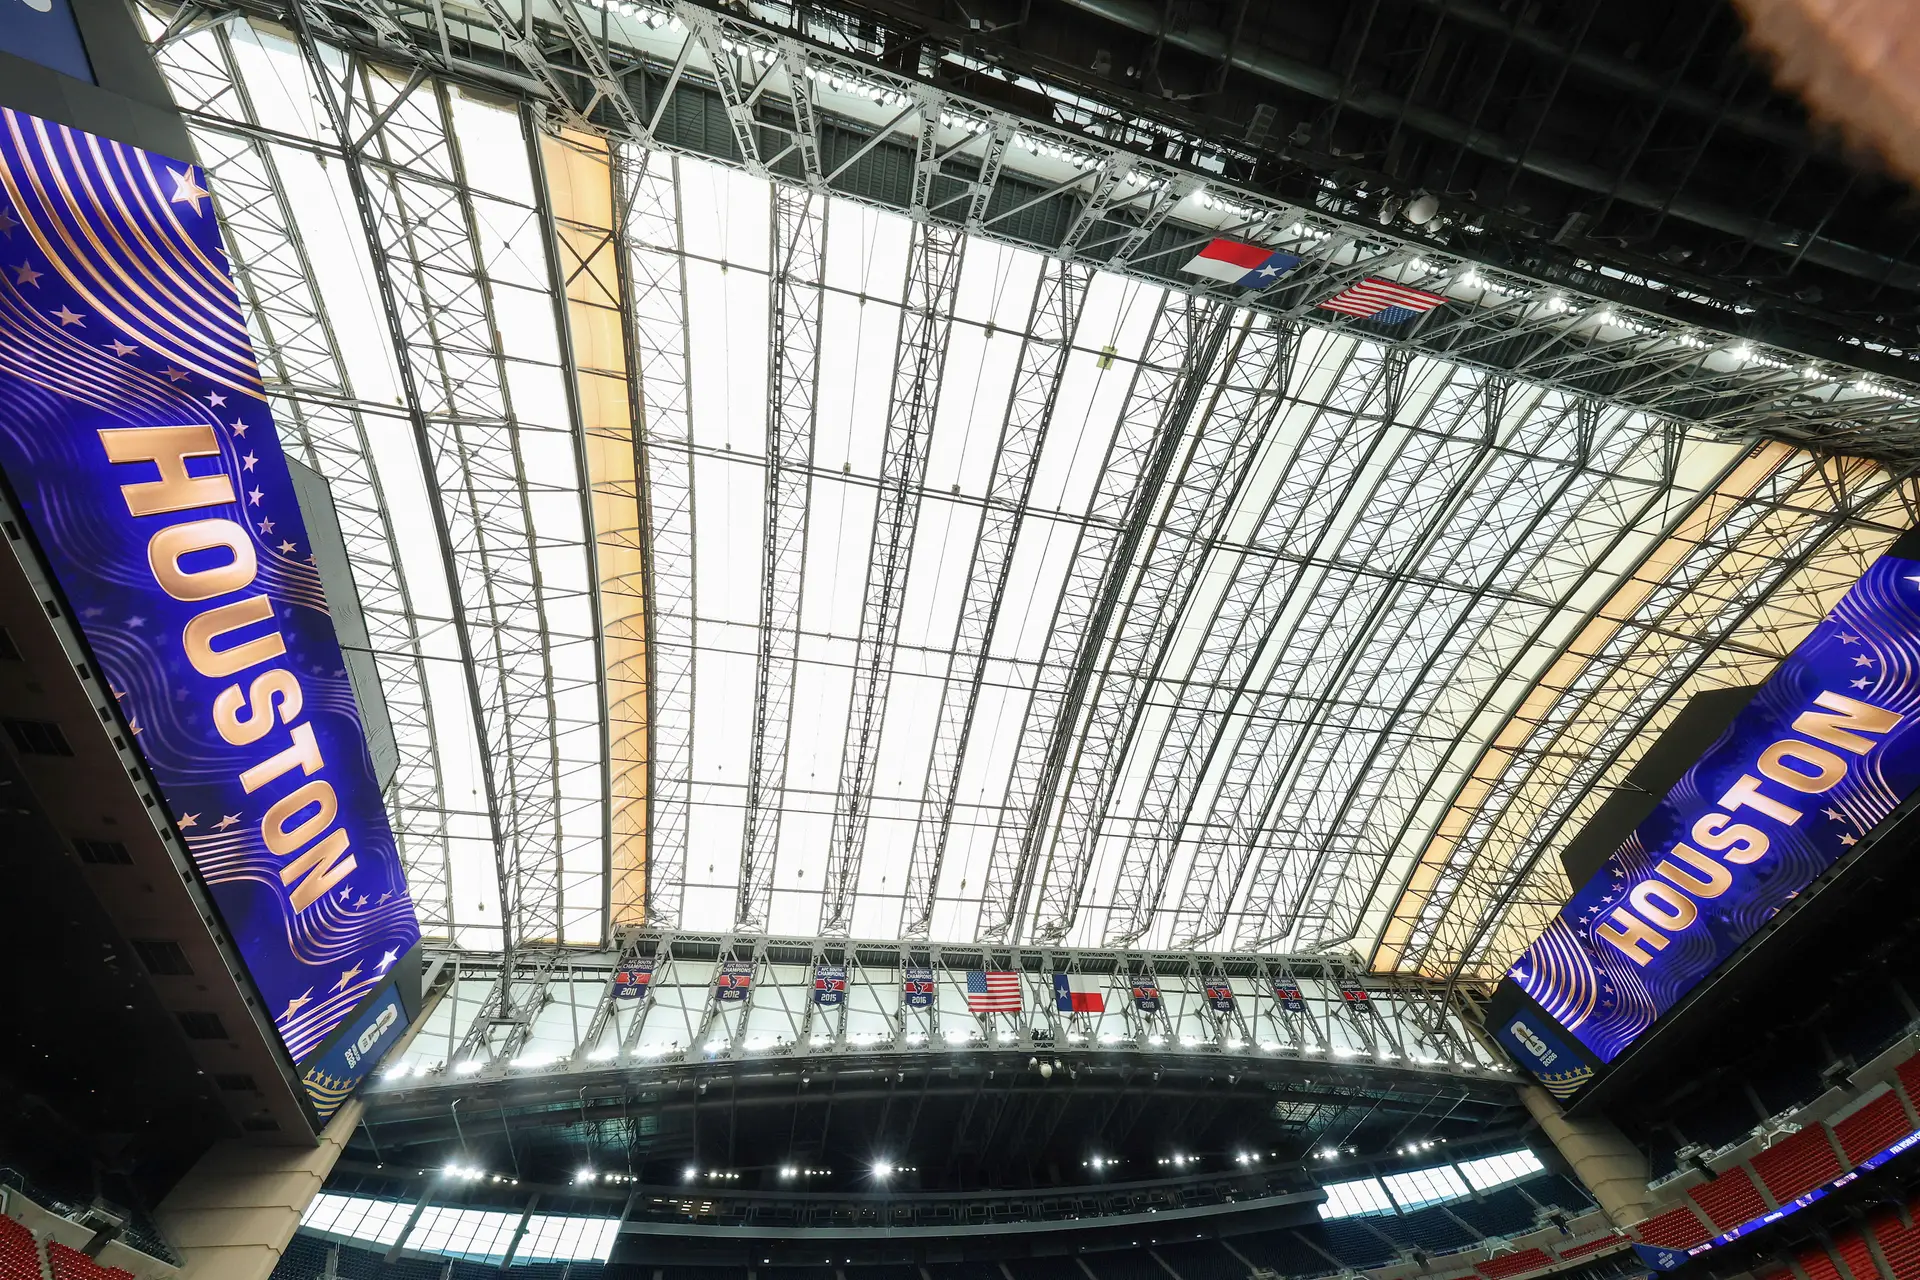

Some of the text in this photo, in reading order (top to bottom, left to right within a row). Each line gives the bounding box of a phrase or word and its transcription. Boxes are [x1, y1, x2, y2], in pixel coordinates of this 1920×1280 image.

[97, 424, 357, 915] HOUSTON
[1595, 690, 1904, 967] HOUSTON
[620, 987, 638, 996] 2011
[820, 993, 837, 1002] 2015
[911, 996, 927, 1004] 2016
[344, 1048, 357, 1069] 2026
[1542, 1052, 1558, 1067] 2026
